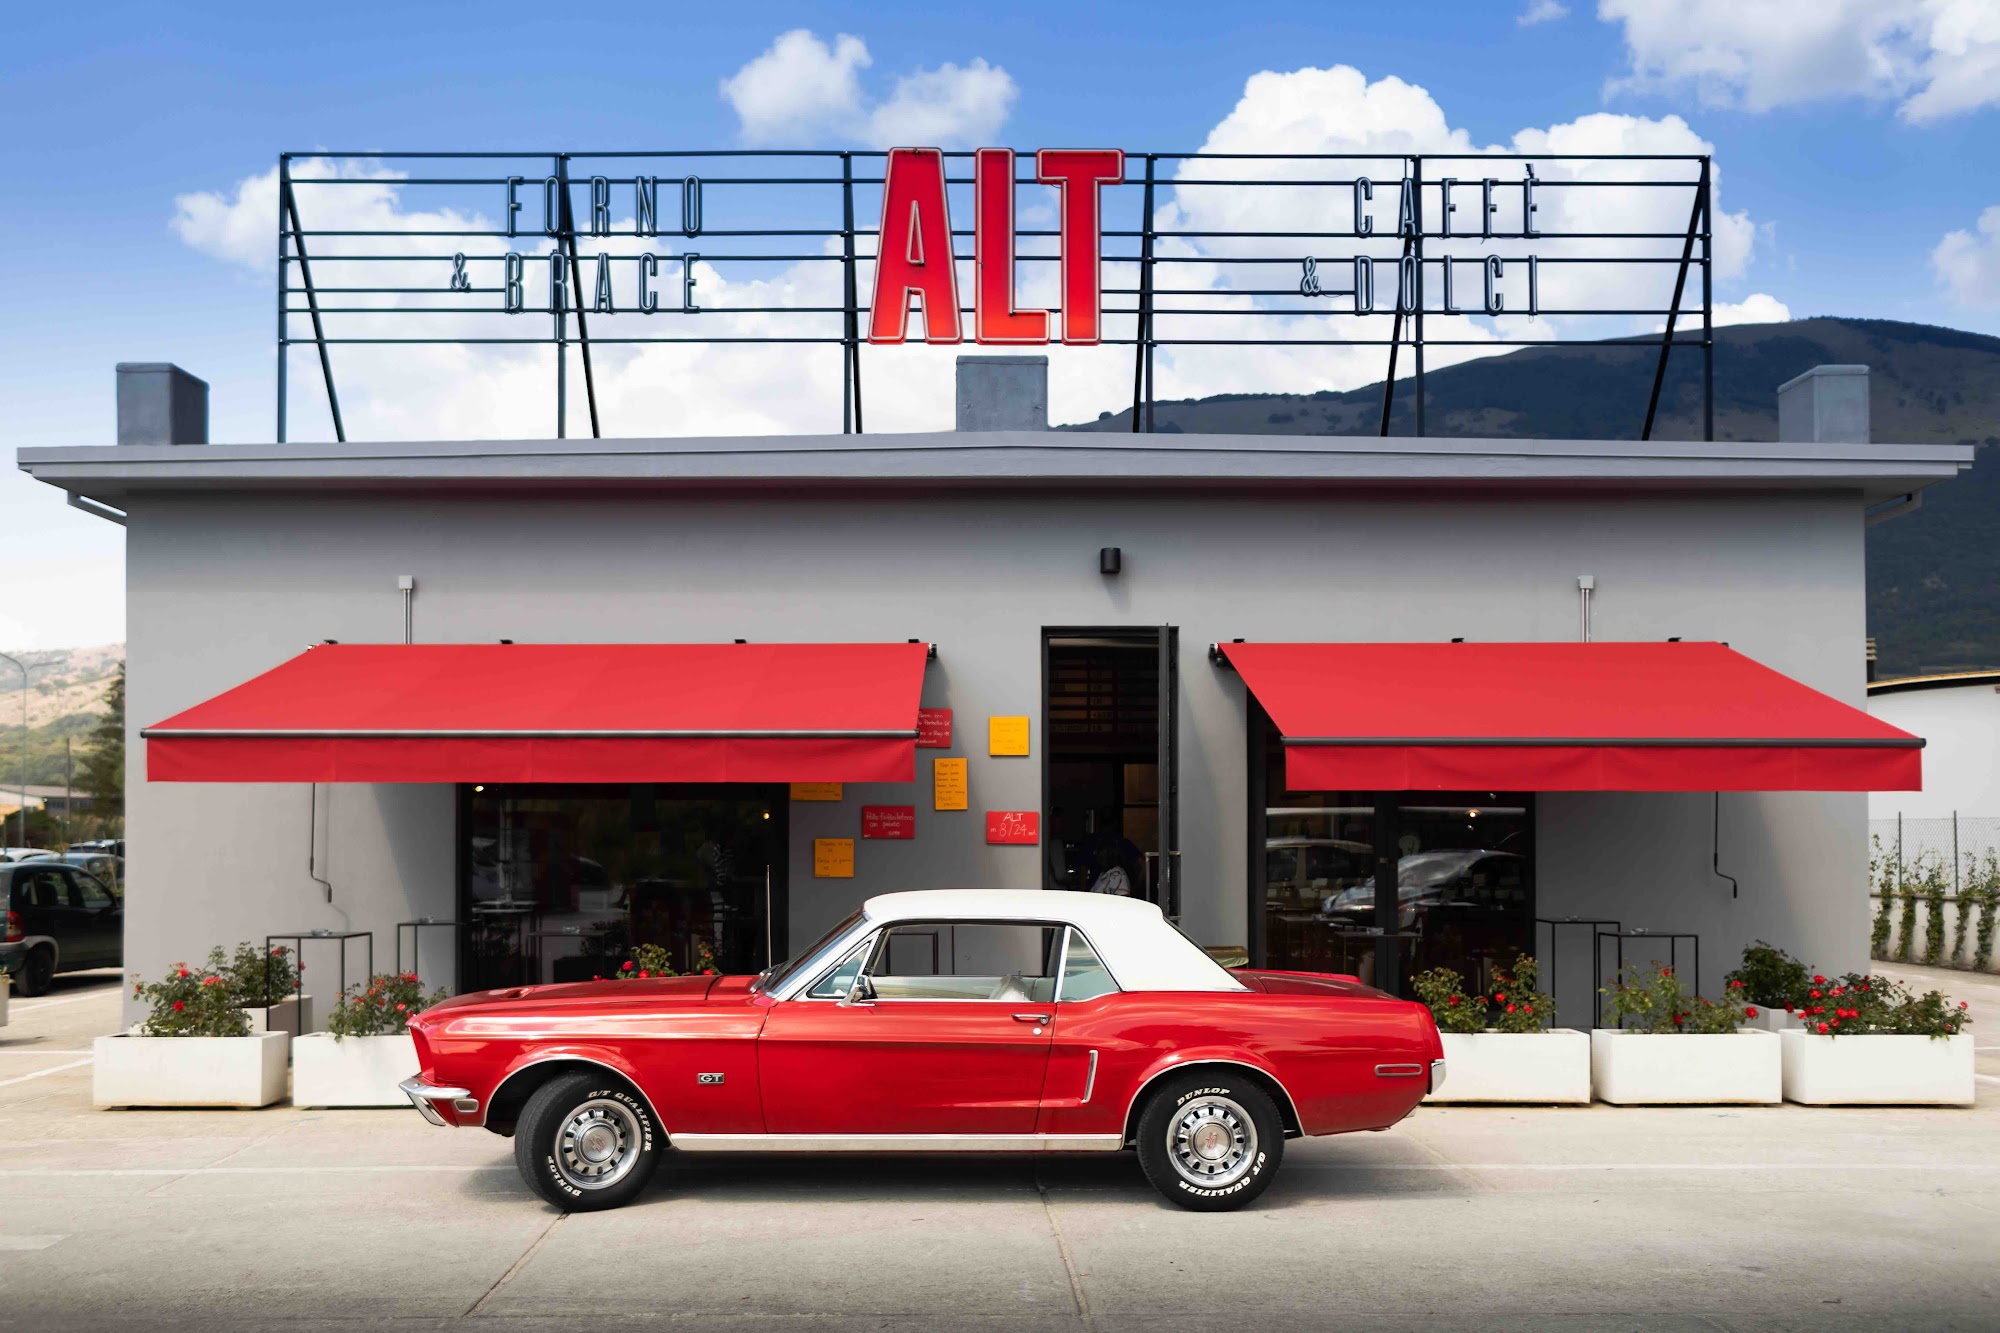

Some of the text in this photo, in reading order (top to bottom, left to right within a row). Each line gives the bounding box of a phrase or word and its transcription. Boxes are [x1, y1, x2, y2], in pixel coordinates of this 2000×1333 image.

[507, 175, 703, 238] FORNO
[1354, 163, 1540, 238] CAFFÈ
[867, 147, 1125, 345] ALT
[450, 252, 700, 314] & BRACE
[1300, 254, 1538, 316] & DOLCI
[1003, 812, 1024, 822] ALT
[589, 1090, 652, 1152] G/T QUALIFIER
[1177, 1088, 1230, 1106] DUNLOP
[546, 1156, 583, 1197] DUNLOP
[1179, 1152, 1266, 1197] G/T QUALIFIER
